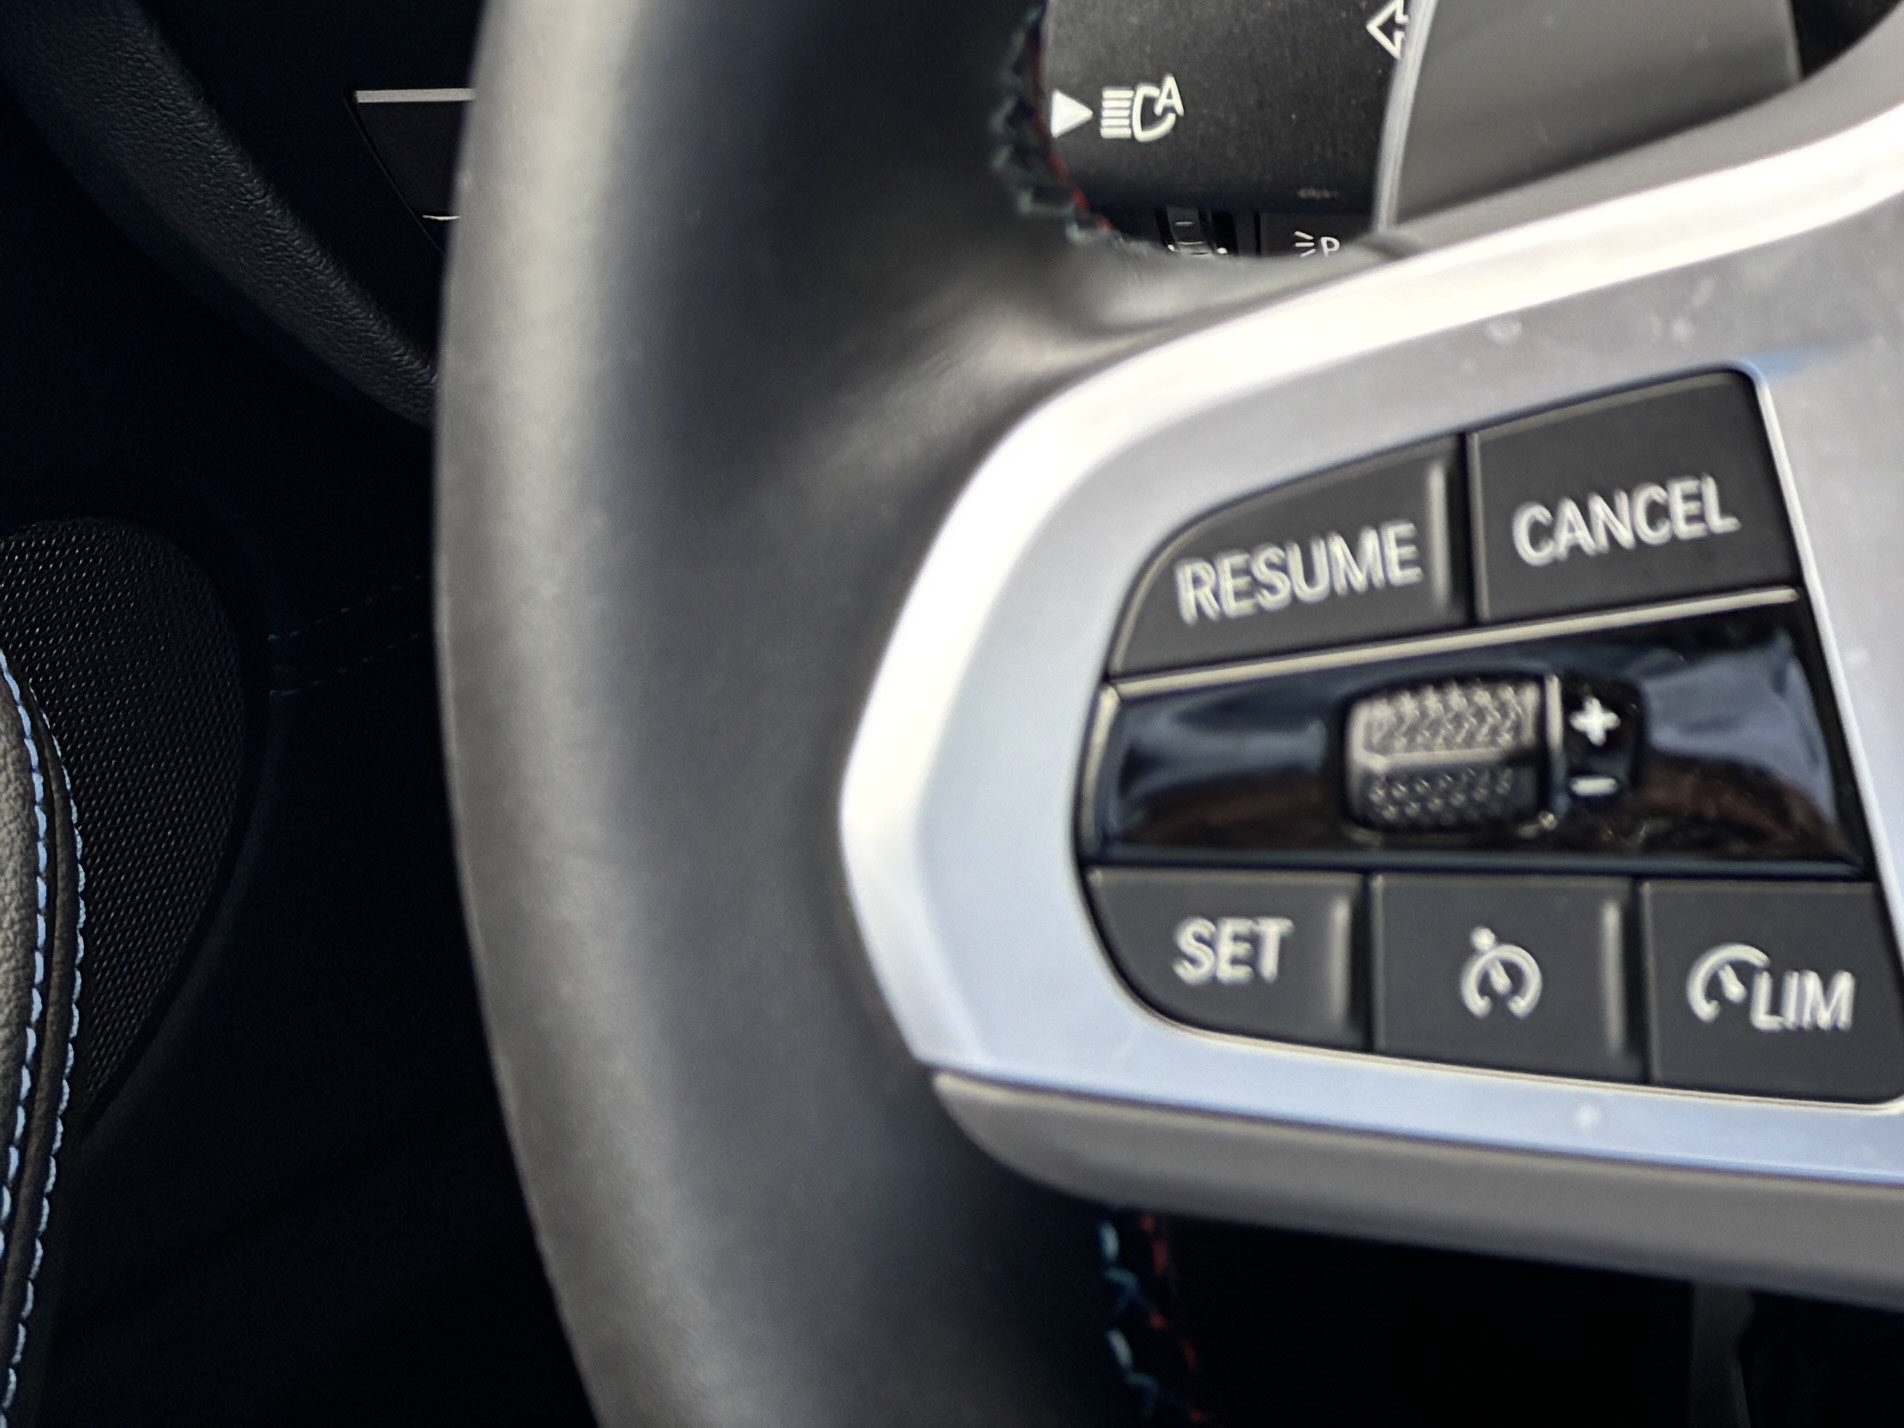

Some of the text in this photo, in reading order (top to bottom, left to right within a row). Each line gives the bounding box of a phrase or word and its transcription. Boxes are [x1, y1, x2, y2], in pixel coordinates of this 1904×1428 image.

[1512, 476, 1738, 566] CANCEL
[1174, 519, 1423, 625] RESUME
[1174, 918, 1293, 983] SET
[1750, 971, 1854, 1030] LIM
